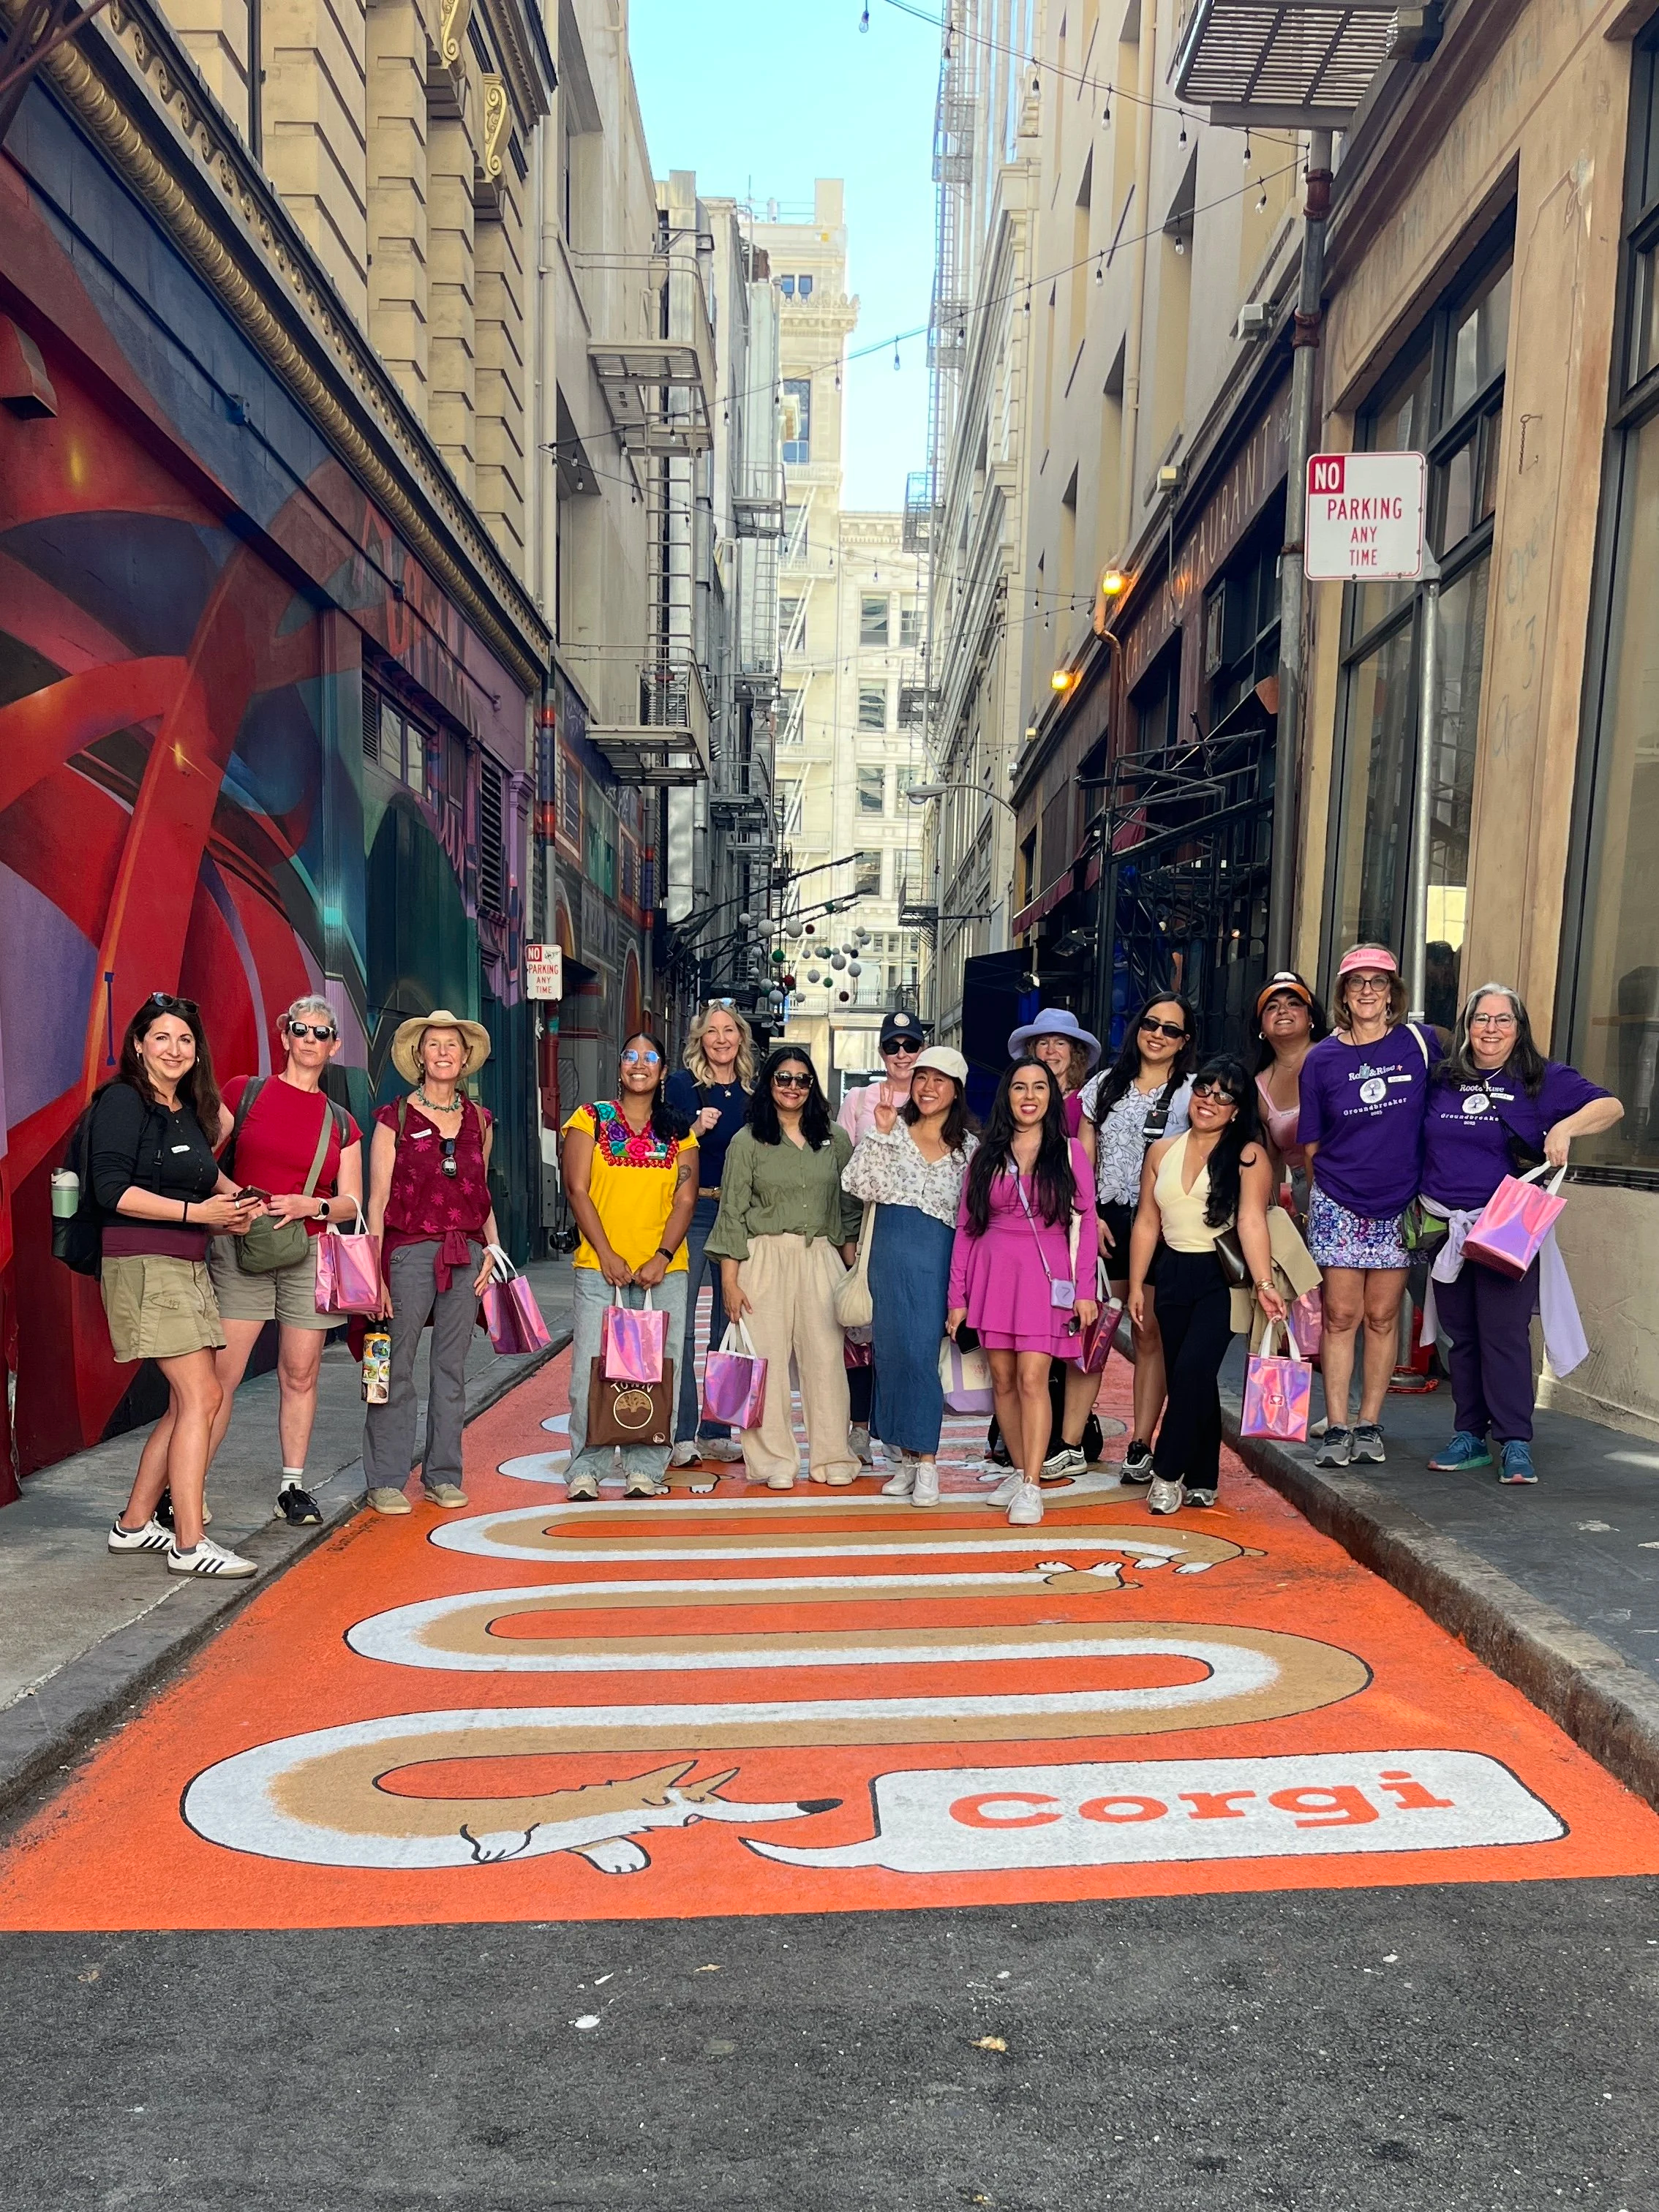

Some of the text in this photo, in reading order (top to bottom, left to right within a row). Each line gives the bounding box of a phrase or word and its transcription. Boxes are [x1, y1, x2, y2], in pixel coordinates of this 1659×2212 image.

[1314, 462, 1340, 489] NO
[1327, 497, 1402, 521] PARKING
[1161, 414, 1271, 634] RESTAURANT
[1350, 526, 1377, 543] ANY
[1350, 549, 1377, 566] TIME
[528, 947, 540, 960] NO
[528, 964, 559, 975] PARKING
[535, 985, 552, 993] TIME
[1343, 1097, 1407, 1116] Groundbreaker
[1440, 1113, 1500, 1121] Groundbreake
[949, 1770, 1455, 1829] Corgi
